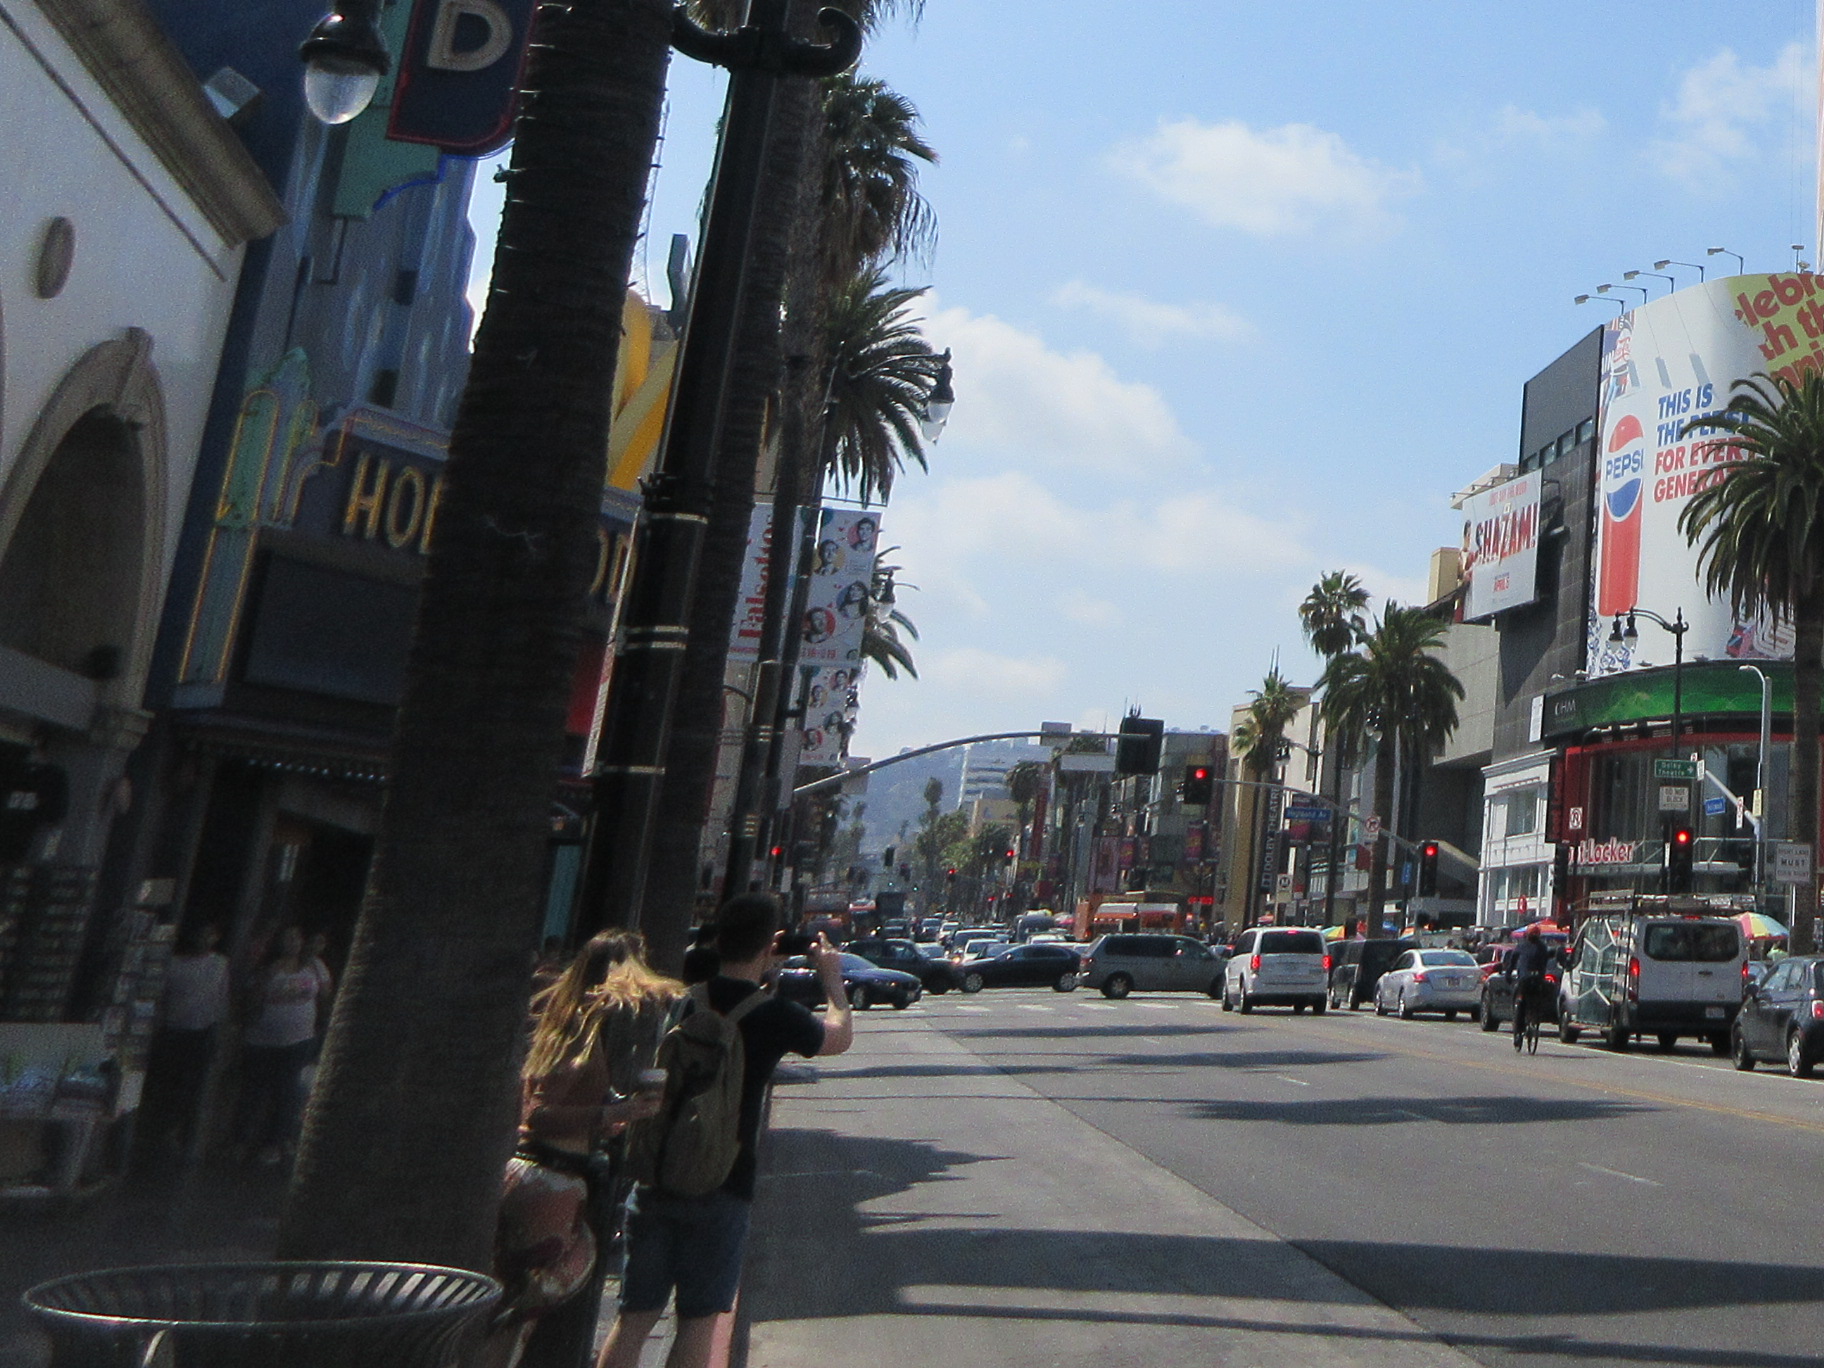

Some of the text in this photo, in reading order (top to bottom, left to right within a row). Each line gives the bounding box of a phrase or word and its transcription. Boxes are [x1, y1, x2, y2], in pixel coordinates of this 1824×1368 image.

[1658, 383, 1713, 420] THIS IS
[1657, 419, 1686, 448] THE
[1605, 448, 1644, 482] PEPSI
[1655, 445, 1686, 476] FOR
[1475, 502, 1538, 564] SHAZAM!
[1263, 787, 1281, 874] DOLBY THEATRE
[1588, 836, 1636, 865] Locker
